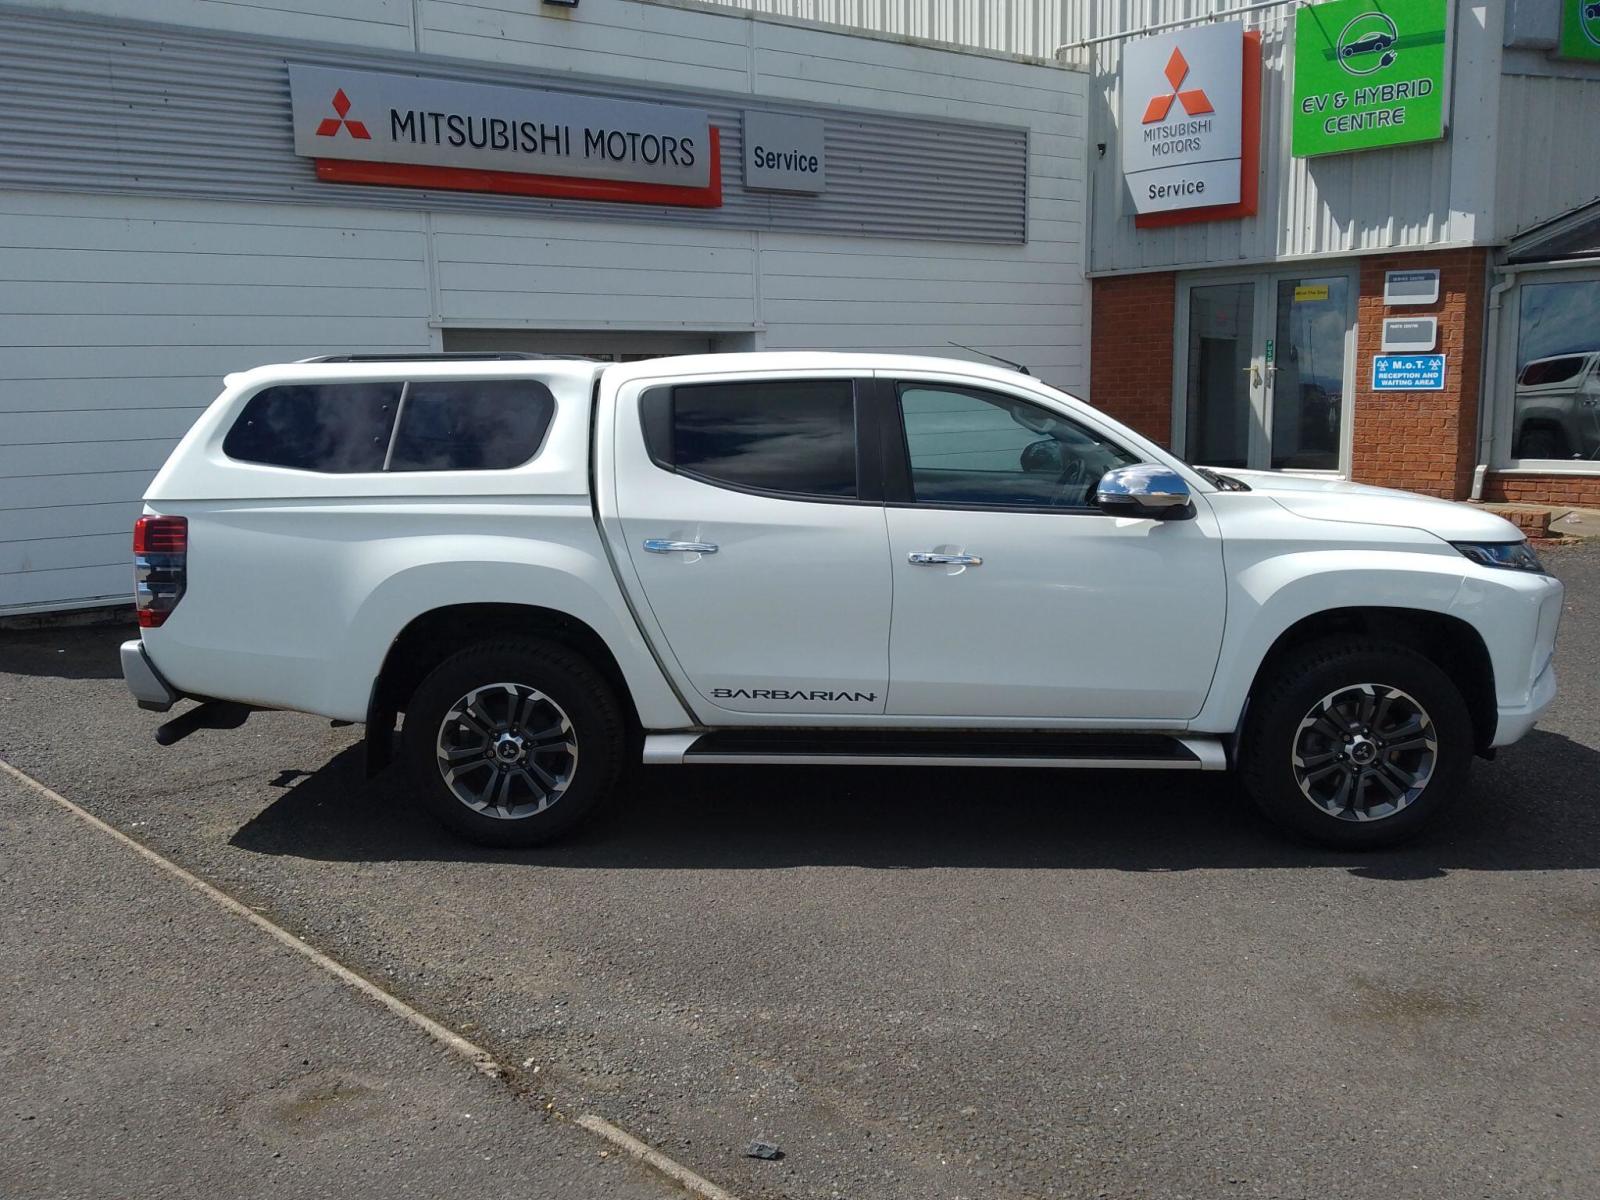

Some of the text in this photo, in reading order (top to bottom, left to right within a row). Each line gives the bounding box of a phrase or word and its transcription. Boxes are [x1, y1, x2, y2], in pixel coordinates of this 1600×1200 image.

[1302, 78, 1433, 114] EV & HYBRID
[1143, 119, 1213, 142] MITSUBISHI
[1324, 106, 1405, 135] CENTRE
[390, 108, 695, 167] MITSUBISHI MOTORS
[1152, 137, 1201, 156] MOTORS
[754, 145, 818, 173] Service
[1148, 180, 1205, 199] Service
[1392, 360, 1425, 369] M.o.T.
[710, 688, 877, 702] BARBARIAN
